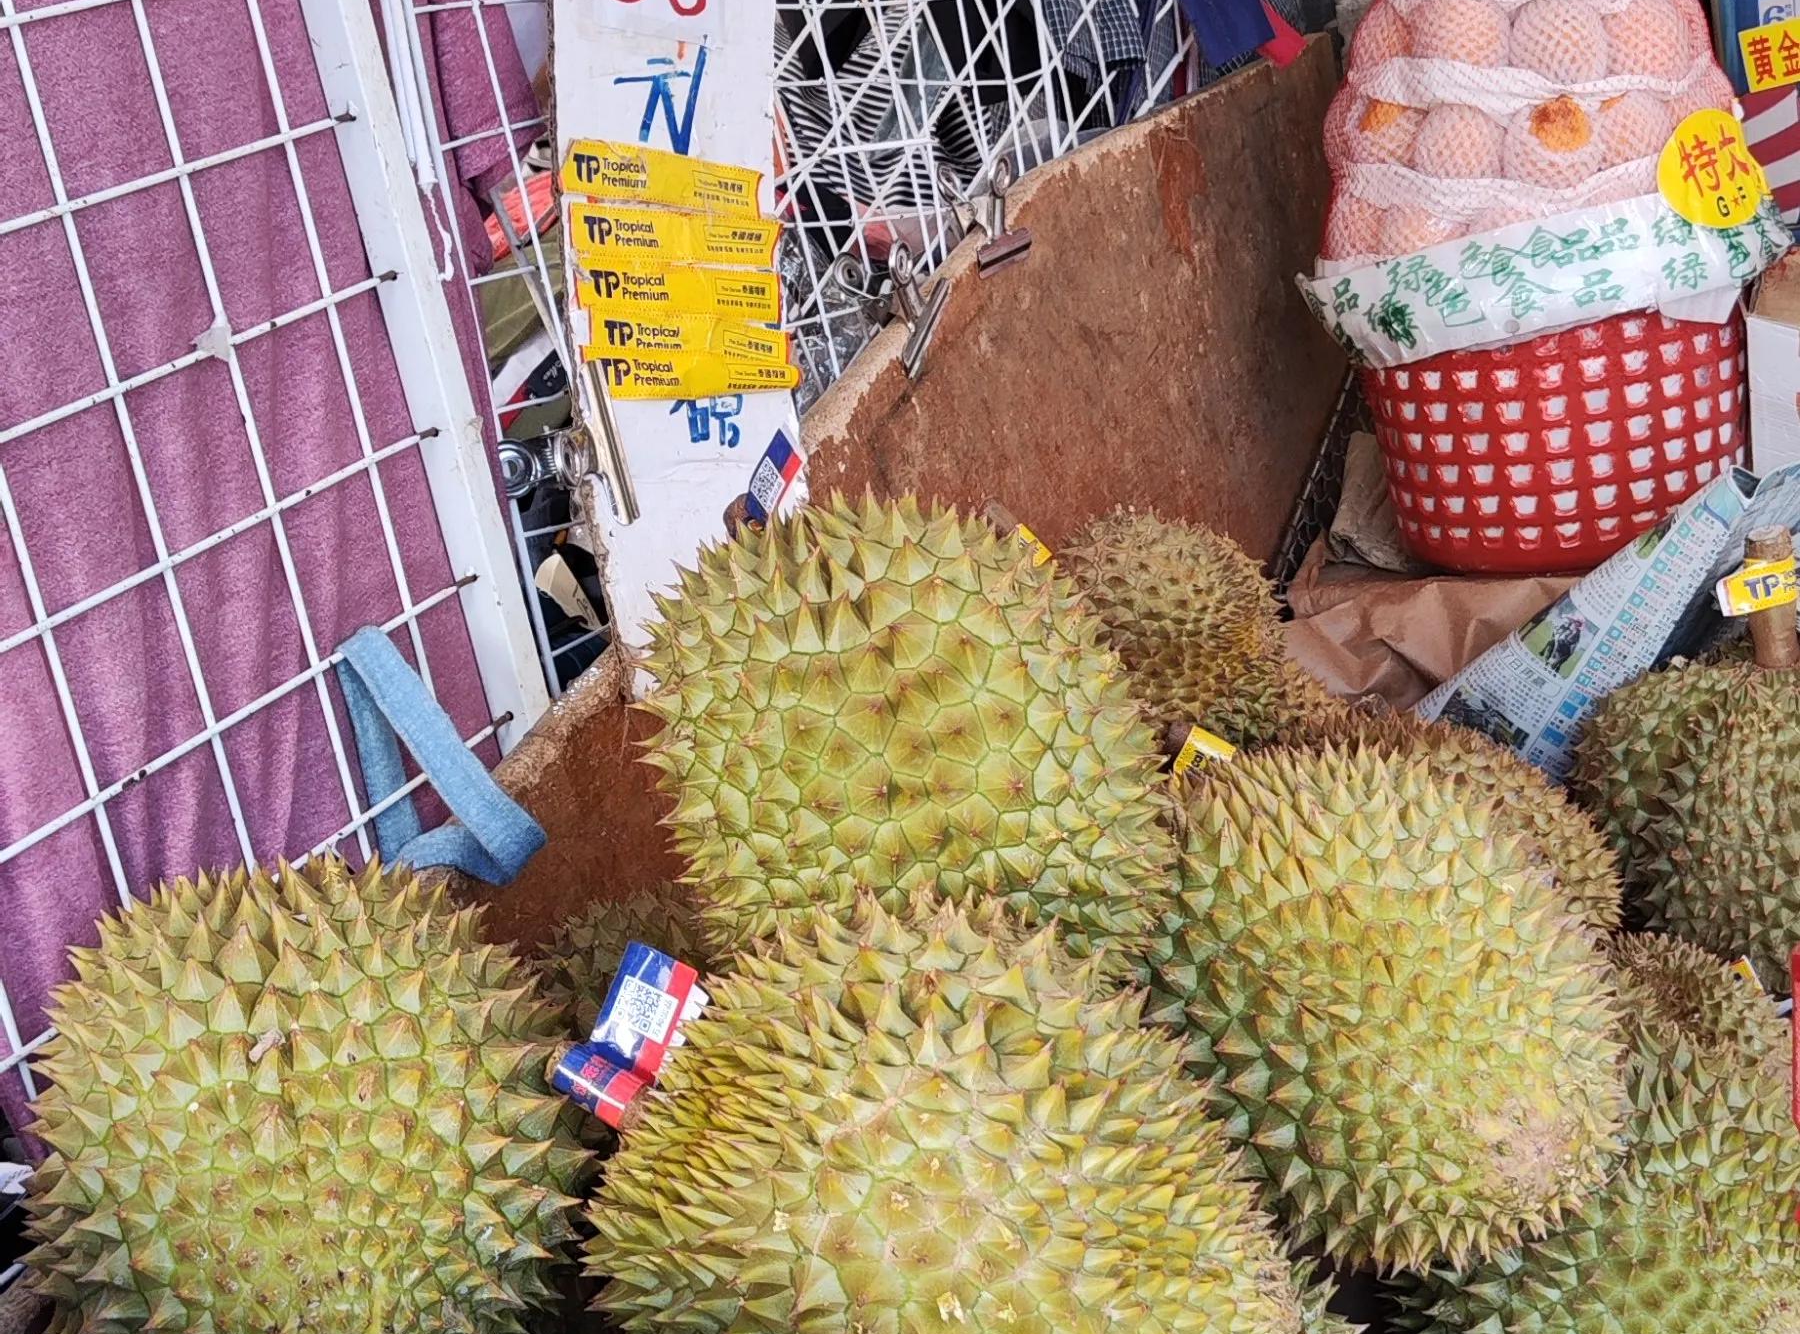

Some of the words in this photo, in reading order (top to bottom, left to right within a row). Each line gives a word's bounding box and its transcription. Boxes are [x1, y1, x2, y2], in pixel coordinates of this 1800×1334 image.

[573, 153, 600, 183] TP
[1680, 123, 1751, 198] 特大
[583, 215, 613, 245] TP
[613, 218, 654, 234] Tropical
[614, 233, 660, 248] Premium
[589, 269, 620, 299] TP
[622, 272, 665, 287] Tropical
[622, 286, 670, 301] Premium
[604, 319, 634, 346] TP
[636, 323, 680, 338] Tropical
[597, 357, 631, 386] TP
[632, 359, 673, 373] Tropical
[634, 373, 680, 386] Premium
[1743, 573, 1780, 600] TP
